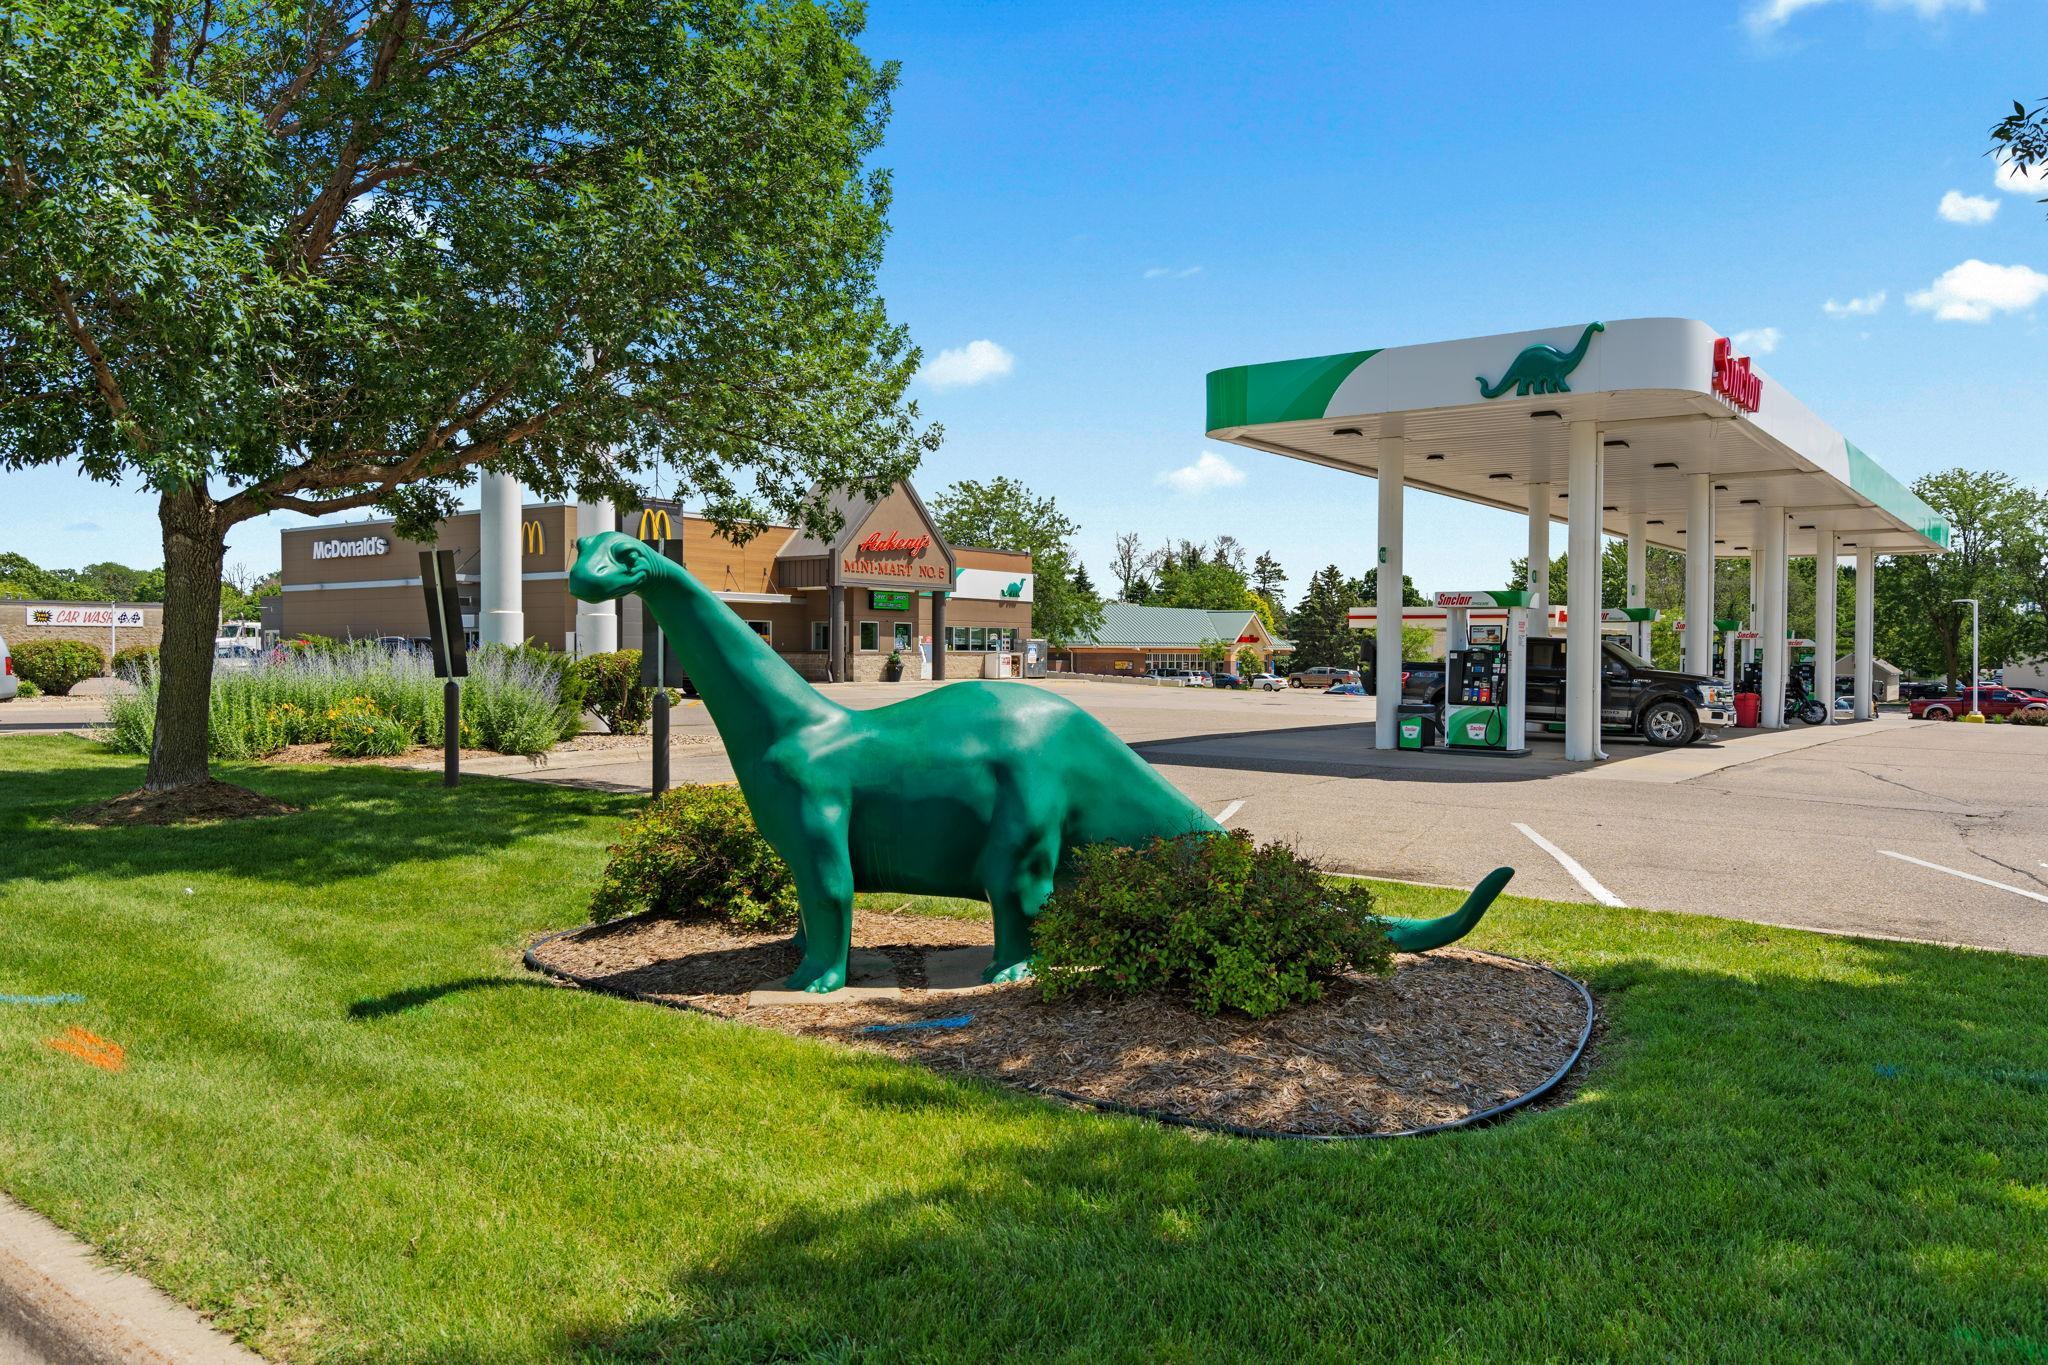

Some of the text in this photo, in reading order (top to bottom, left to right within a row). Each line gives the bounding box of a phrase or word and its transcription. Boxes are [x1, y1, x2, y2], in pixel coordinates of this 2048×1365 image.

[313, 536, 386, 560] McDonald's
[919, 565, 936, 579] NO.
[1438, 593, 1472, 606] Sinclair
[56, 610, 113, 624] CAR WASH
[1737, 631, 1760, 639] Sinclair
